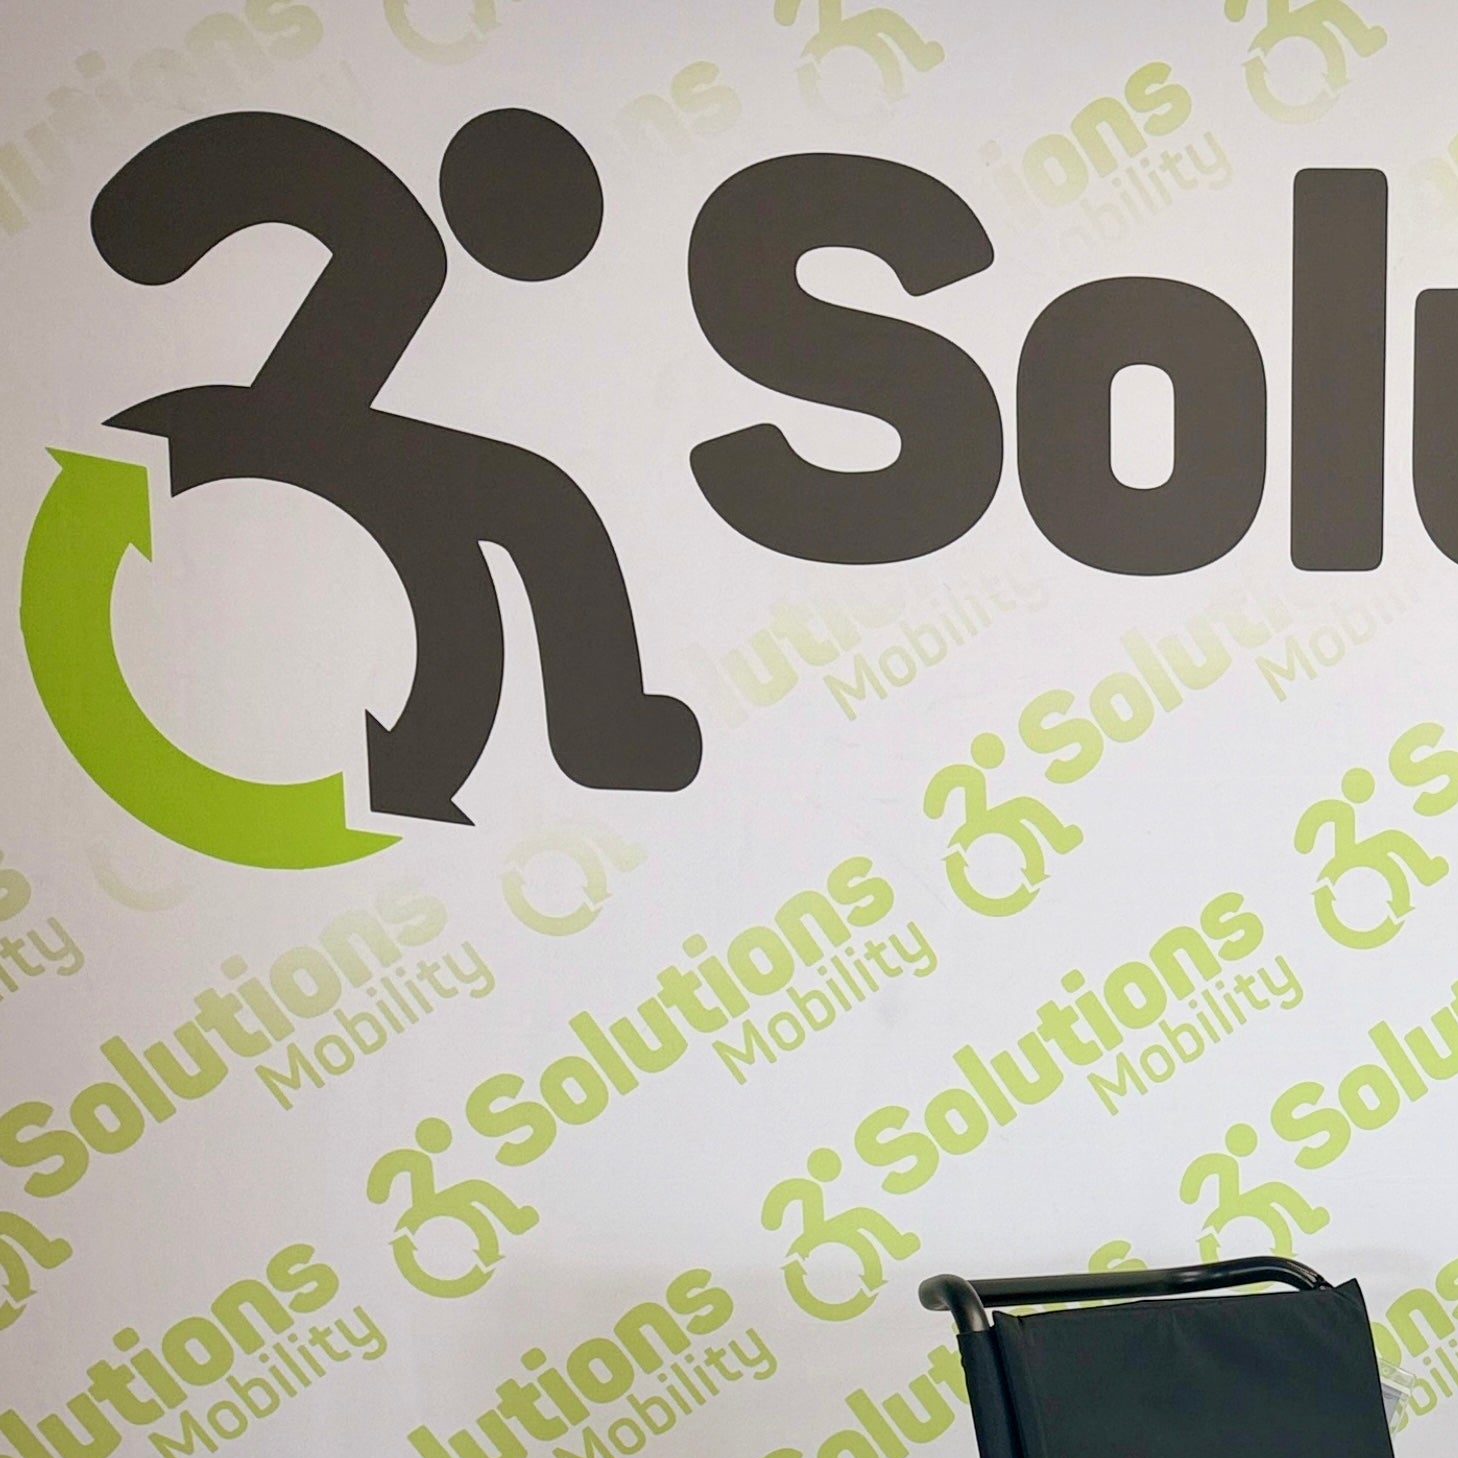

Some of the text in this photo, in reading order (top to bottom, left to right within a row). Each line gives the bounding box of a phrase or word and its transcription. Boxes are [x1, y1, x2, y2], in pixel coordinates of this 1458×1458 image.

[0, 888, 447, 1198] Solutions
[254, 941, 496, 1111] Mobility
[466, 856, 894, 1166] Solutions
[712, 921, 937, 1085] Mobility
[854, 892, 1264, 1194] Solutions
[1087, 955, 1303, 1115] Mobility
